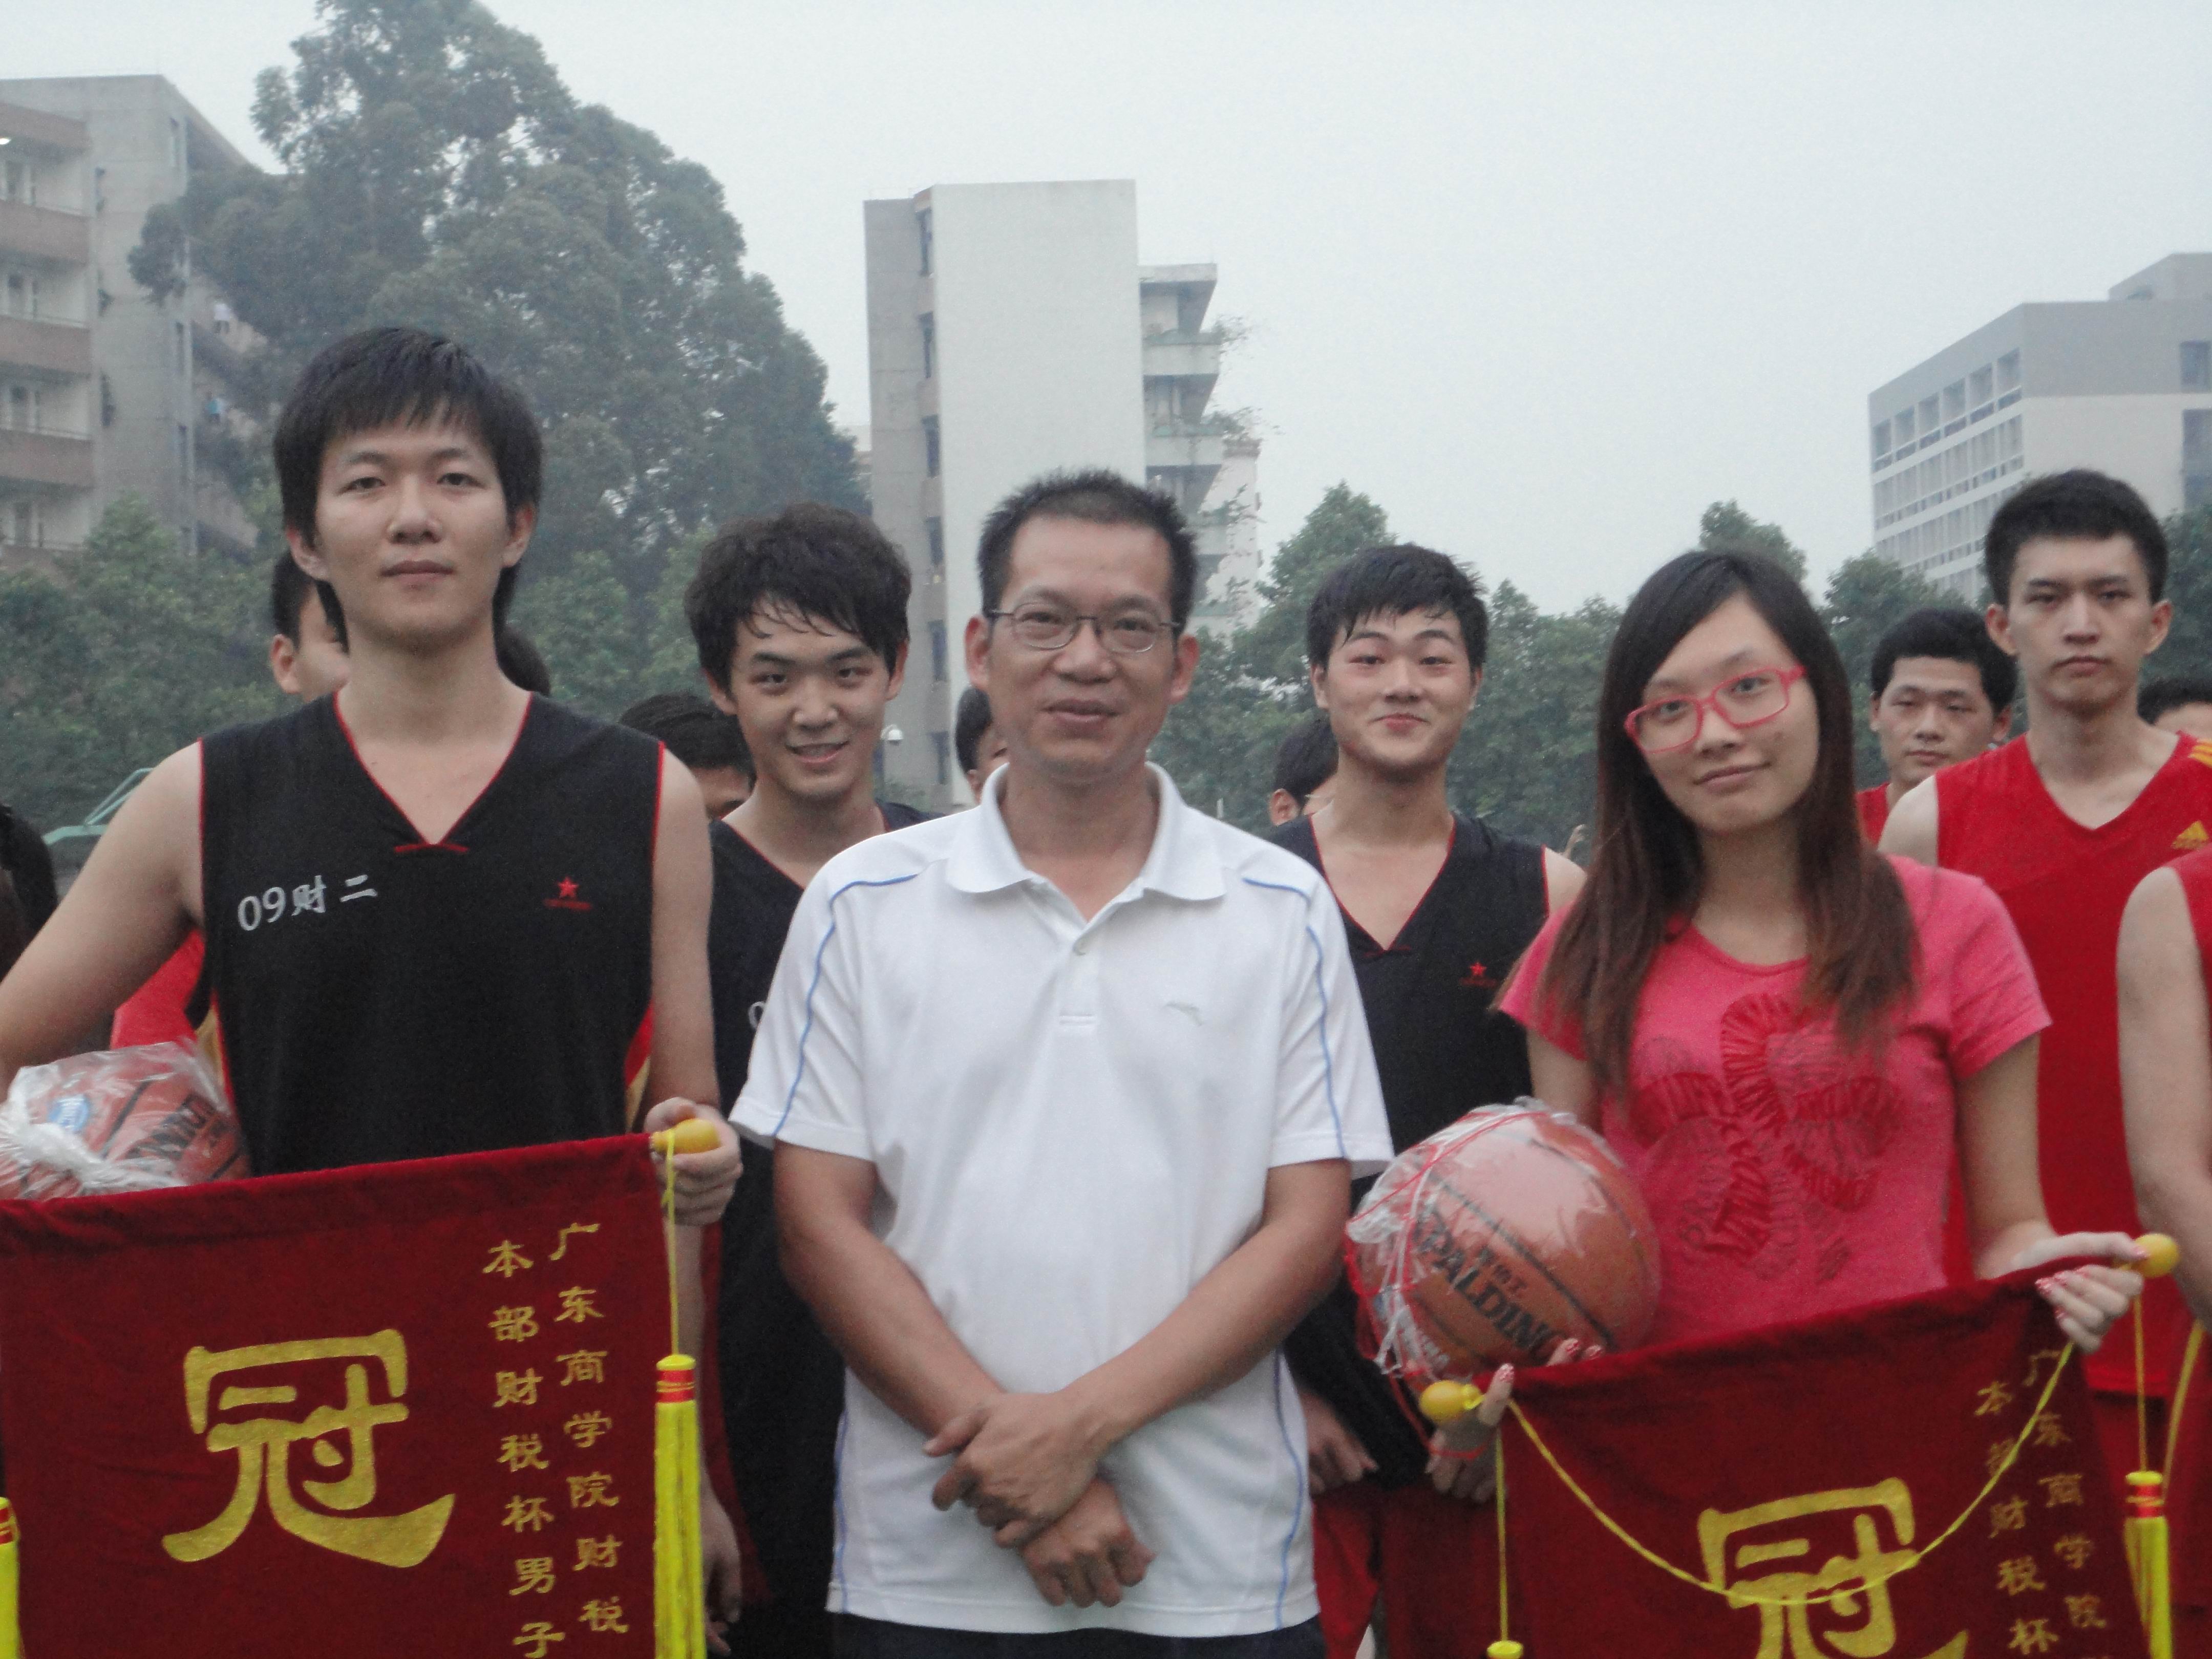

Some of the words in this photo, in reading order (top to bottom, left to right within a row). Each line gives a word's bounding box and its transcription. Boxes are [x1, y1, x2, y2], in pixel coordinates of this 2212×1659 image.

[237, 874, 378, 931] 09财二
[161, 1328, 456, 1568] 冠
[482, 1239, 566, 1659] 本部财税杯男子
[549, 1222, 630, 1634] 广东商学院财税
[1697, 1477, 1968, 1659] 冠
